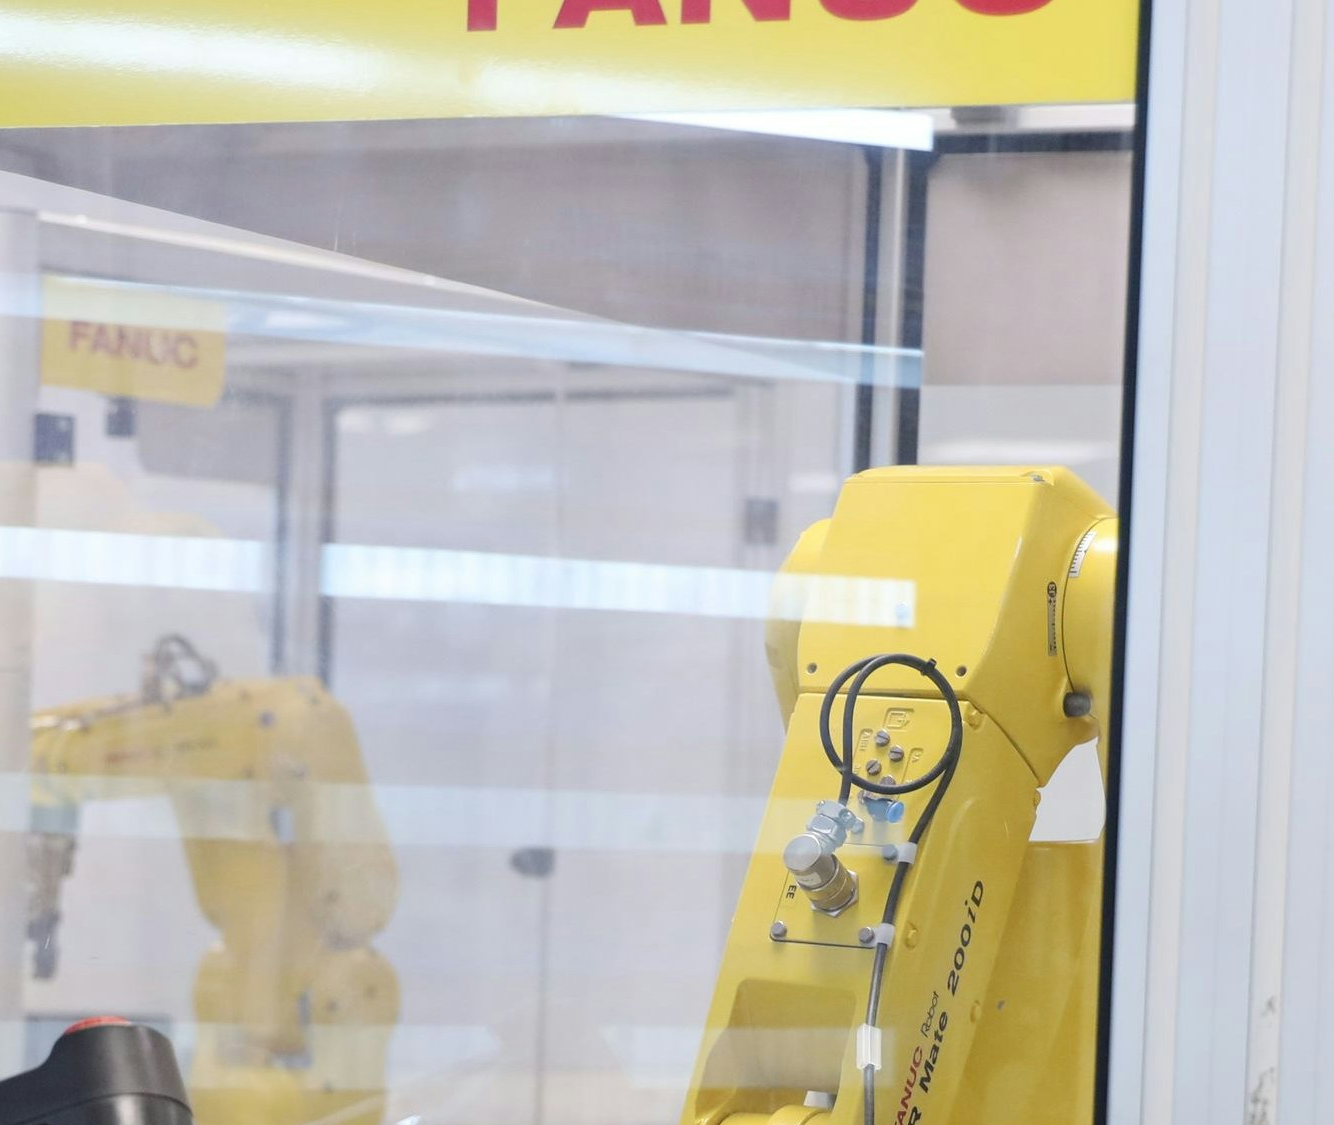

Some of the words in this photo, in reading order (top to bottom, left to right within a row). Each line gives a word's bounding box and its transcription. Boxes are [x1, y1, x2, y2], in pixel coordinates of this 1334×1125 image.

[69, 320, 199, 369] FANUC
[919, 1010, 949, 1094] Mate
[947, 879, 985, 997] 200iD
[920, 990, 940, 1038] Robot
